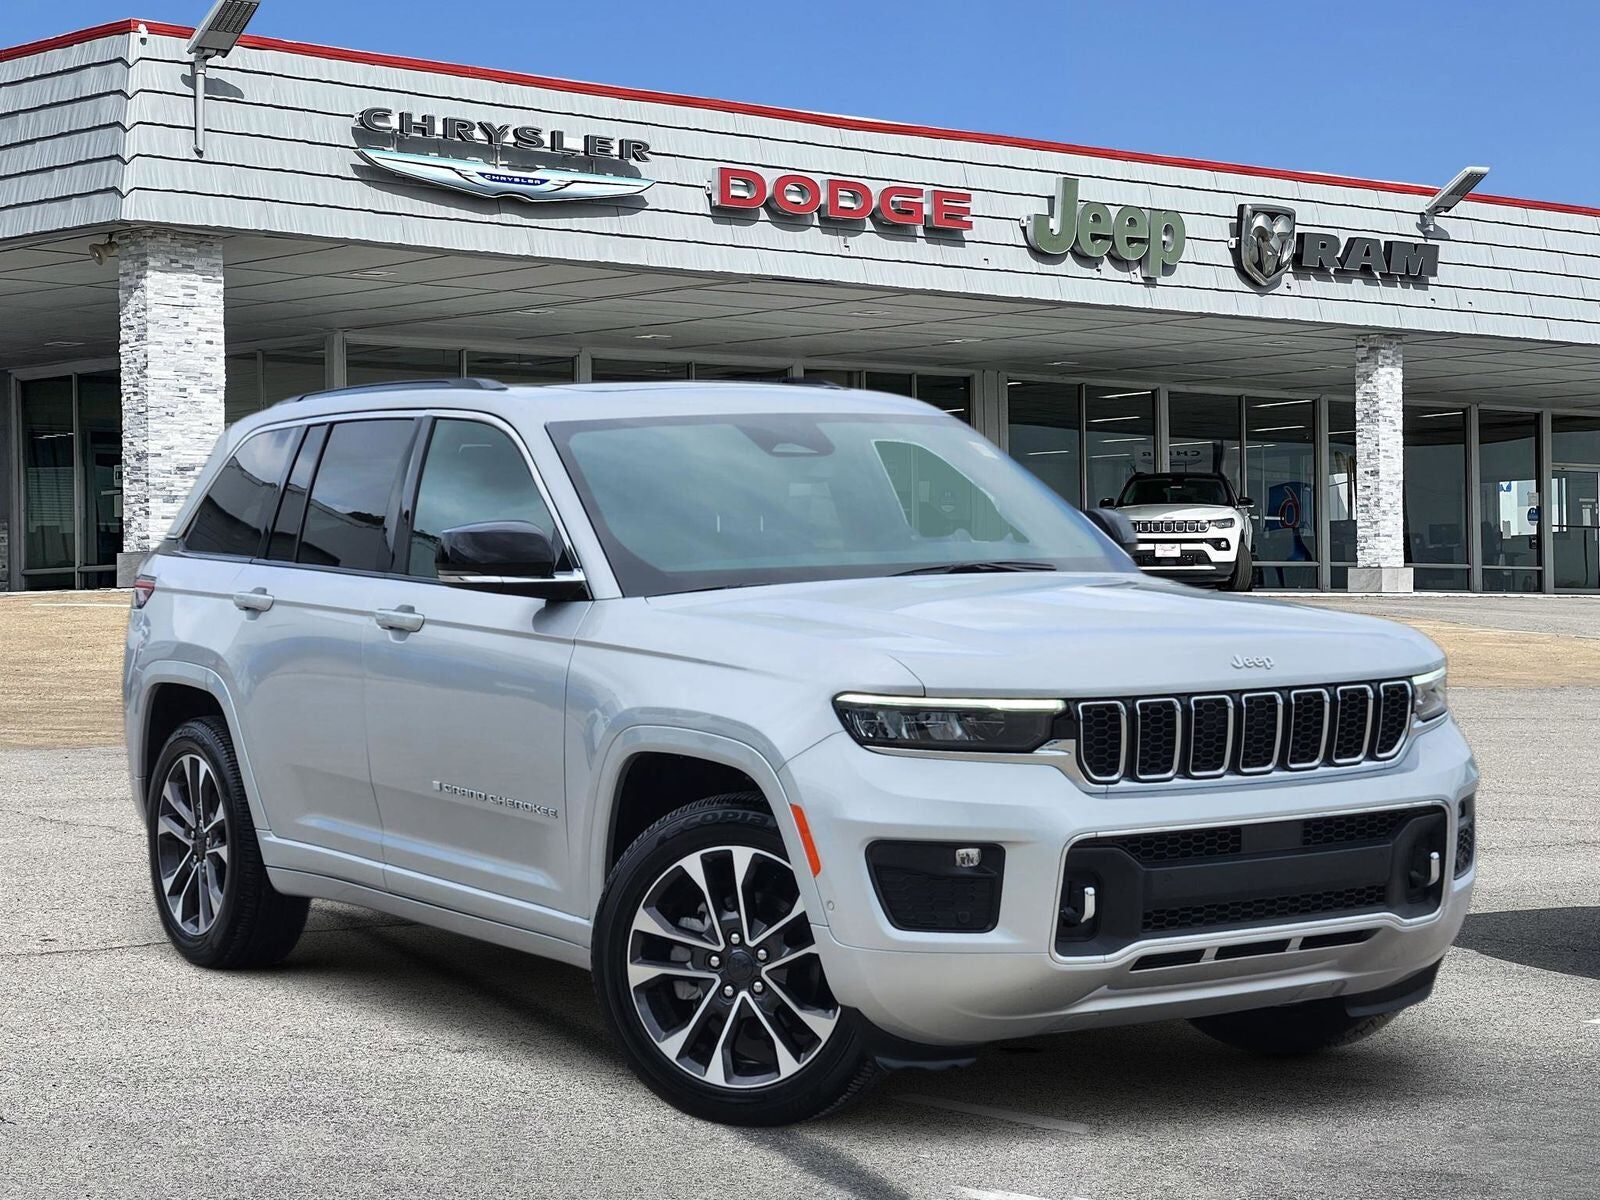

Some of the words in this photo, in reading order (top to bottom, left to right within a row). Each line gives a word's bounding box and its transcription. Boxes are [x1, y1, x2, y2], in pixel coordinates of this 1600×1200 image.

[357, 106, 652, 163] CHRYSLER
[484, 174, 541, 185] CHRYSLER
[712, 166, 974, 232] DODGE
[1027, 176, 1187, 278] Jeep
[1293, 232, 1440, 278] RAM
[1231, 653, 1275, 671] Jeep
[443, 782, 487, 801] GRAND
[489, 793, 559, 819] CHEROKEE
